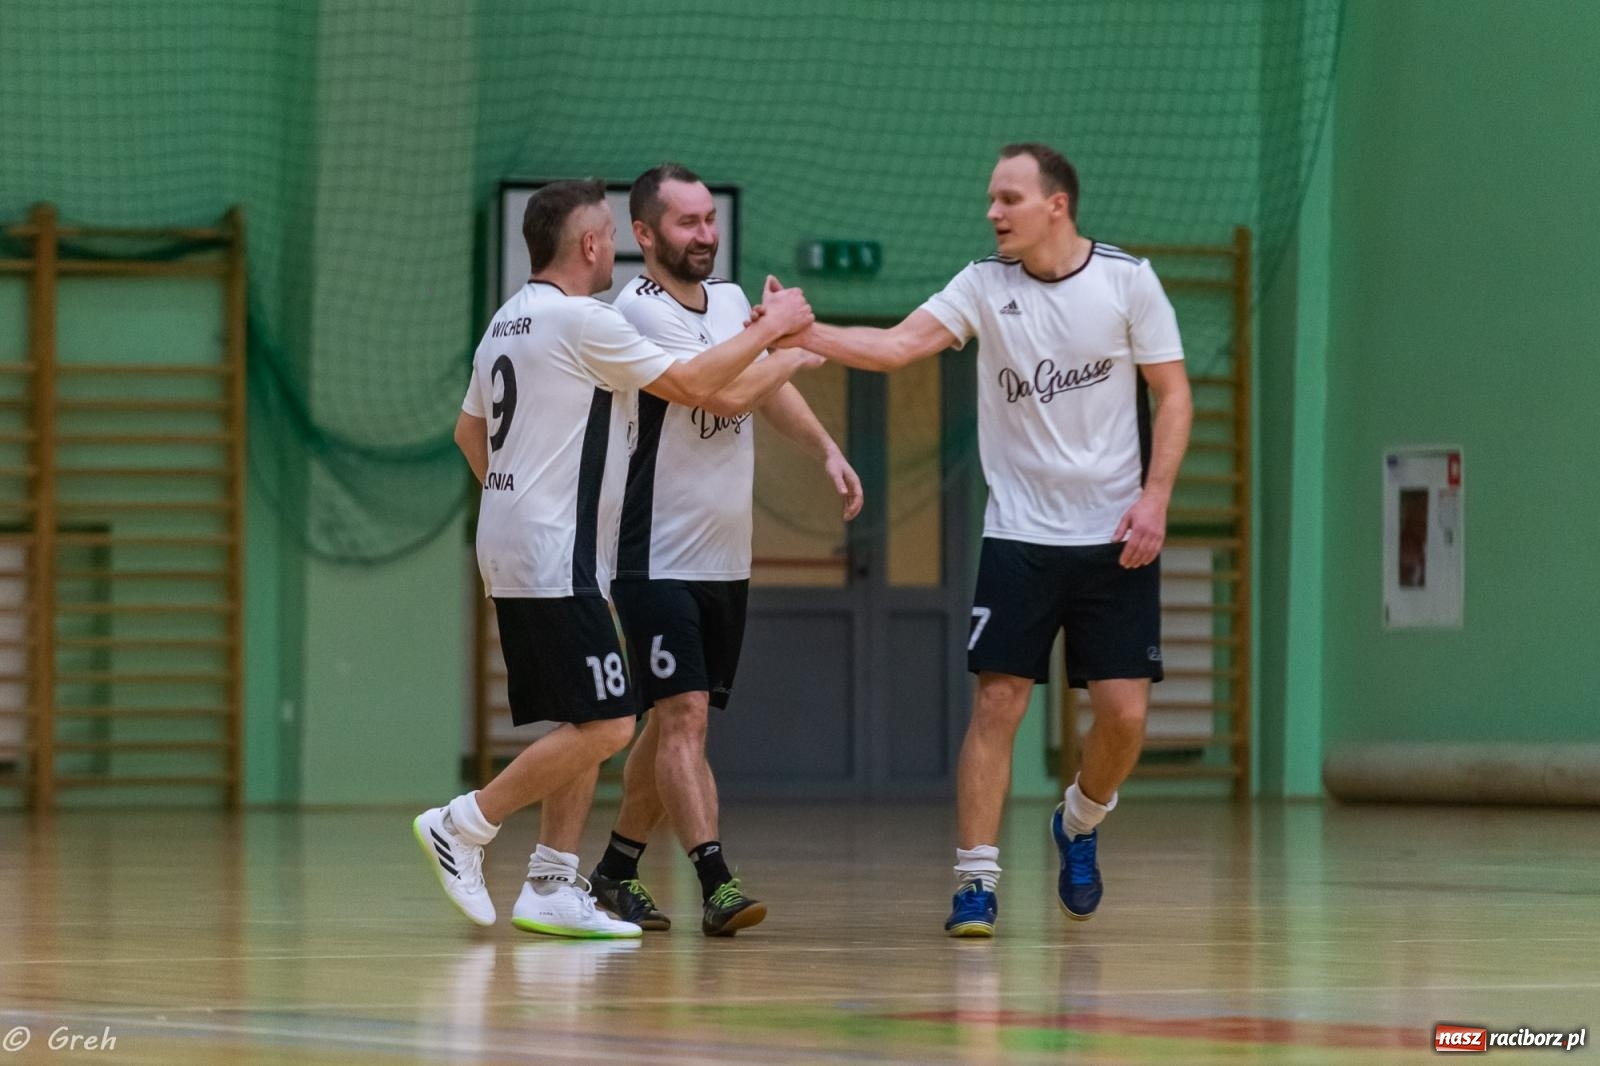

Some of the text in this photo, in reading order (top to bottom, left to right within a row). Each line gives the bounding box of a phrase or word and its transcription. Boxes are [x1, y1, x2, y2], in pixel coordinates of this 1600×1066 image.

[492, 317, 532, 338] WICHER
[490, 354, 518, 453] 9
[967, 606, 992, 650] 7
[585, 652, 626, 701] 18
[650, 634, 677, 680] 6
